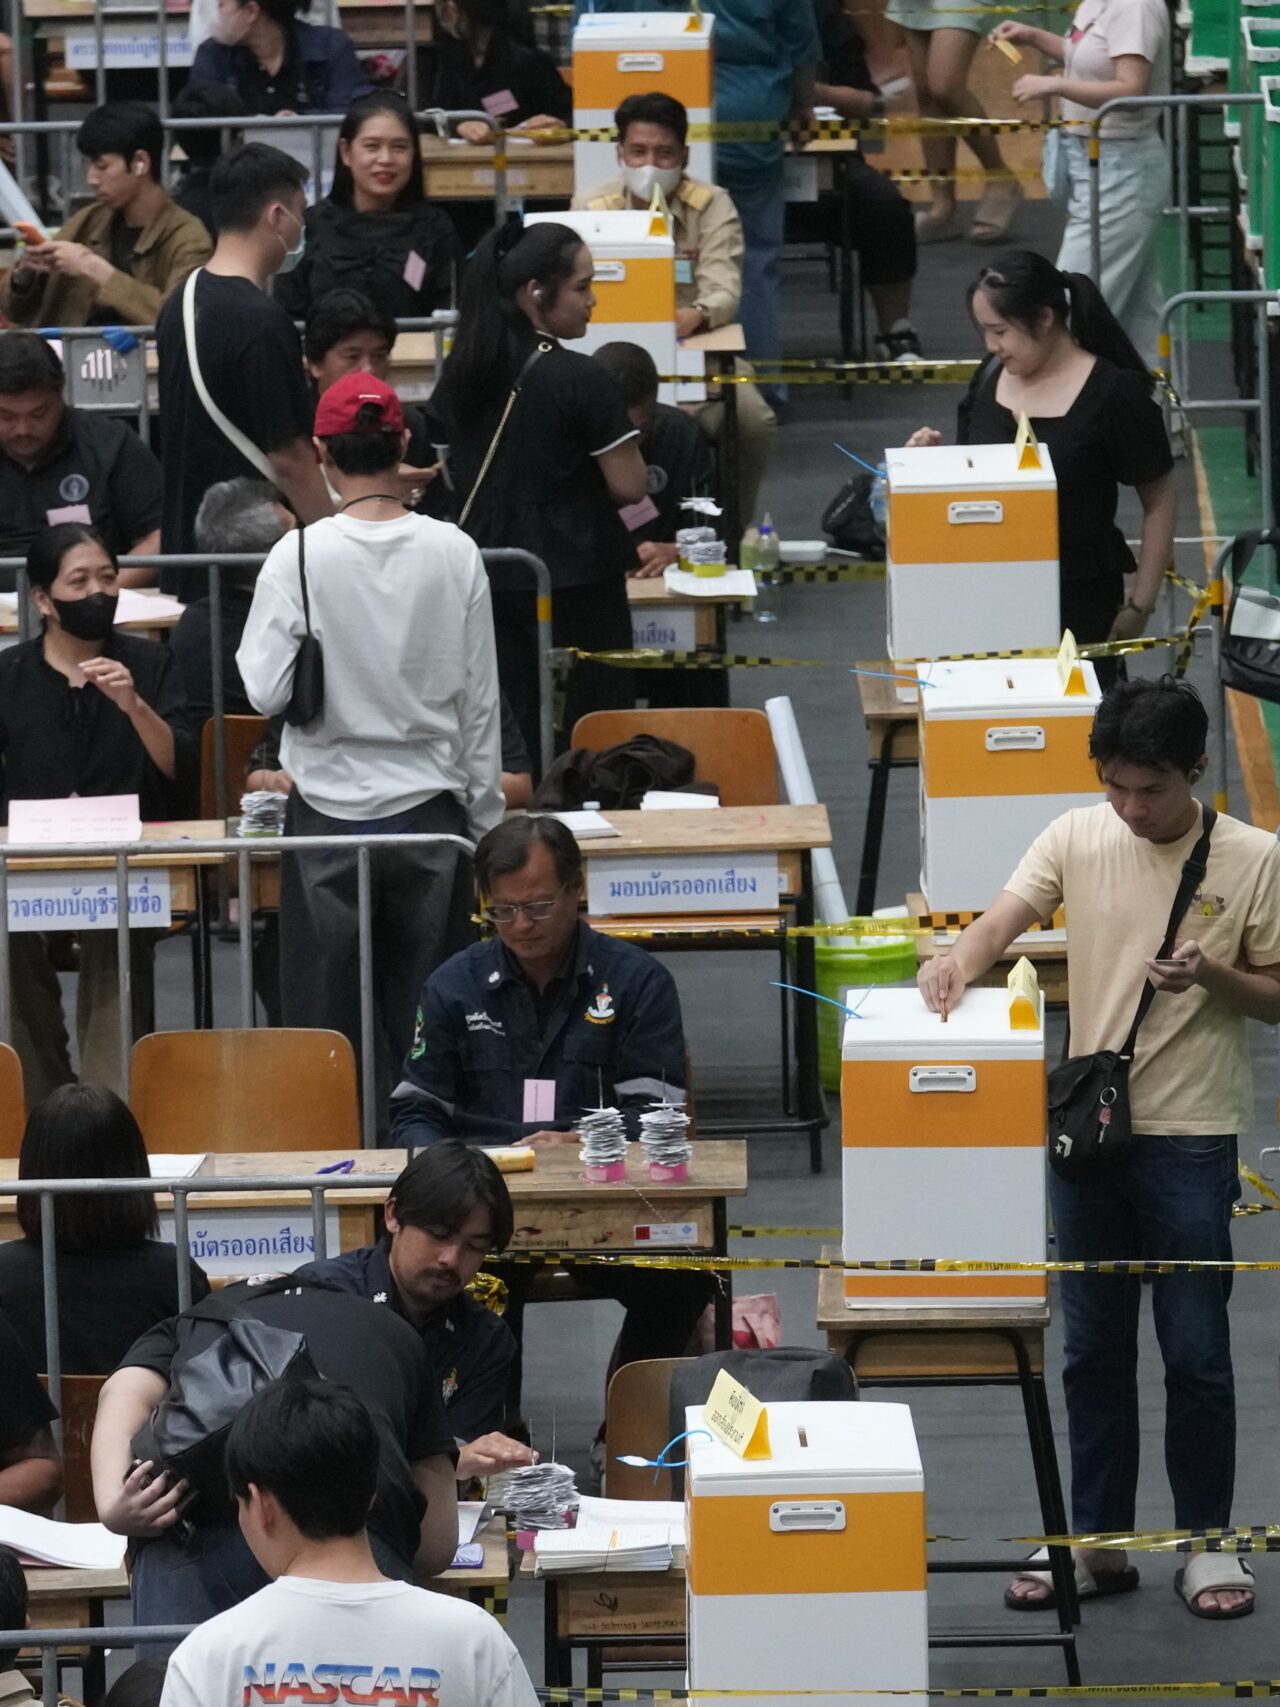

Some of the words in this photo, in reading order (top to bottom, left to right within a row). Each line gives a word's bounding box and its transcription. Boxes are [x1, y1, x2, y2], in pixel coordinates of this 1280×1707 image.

[9, 877, 162, 922] วจสอบบัญชีรยชื่อ
[610, 869, 757, 898] มอบบัตรออกเสียง
[188, 1226, 316, 1258] บัตรออกเสียง
[243, 1663, 441, 1707] NASCAR
